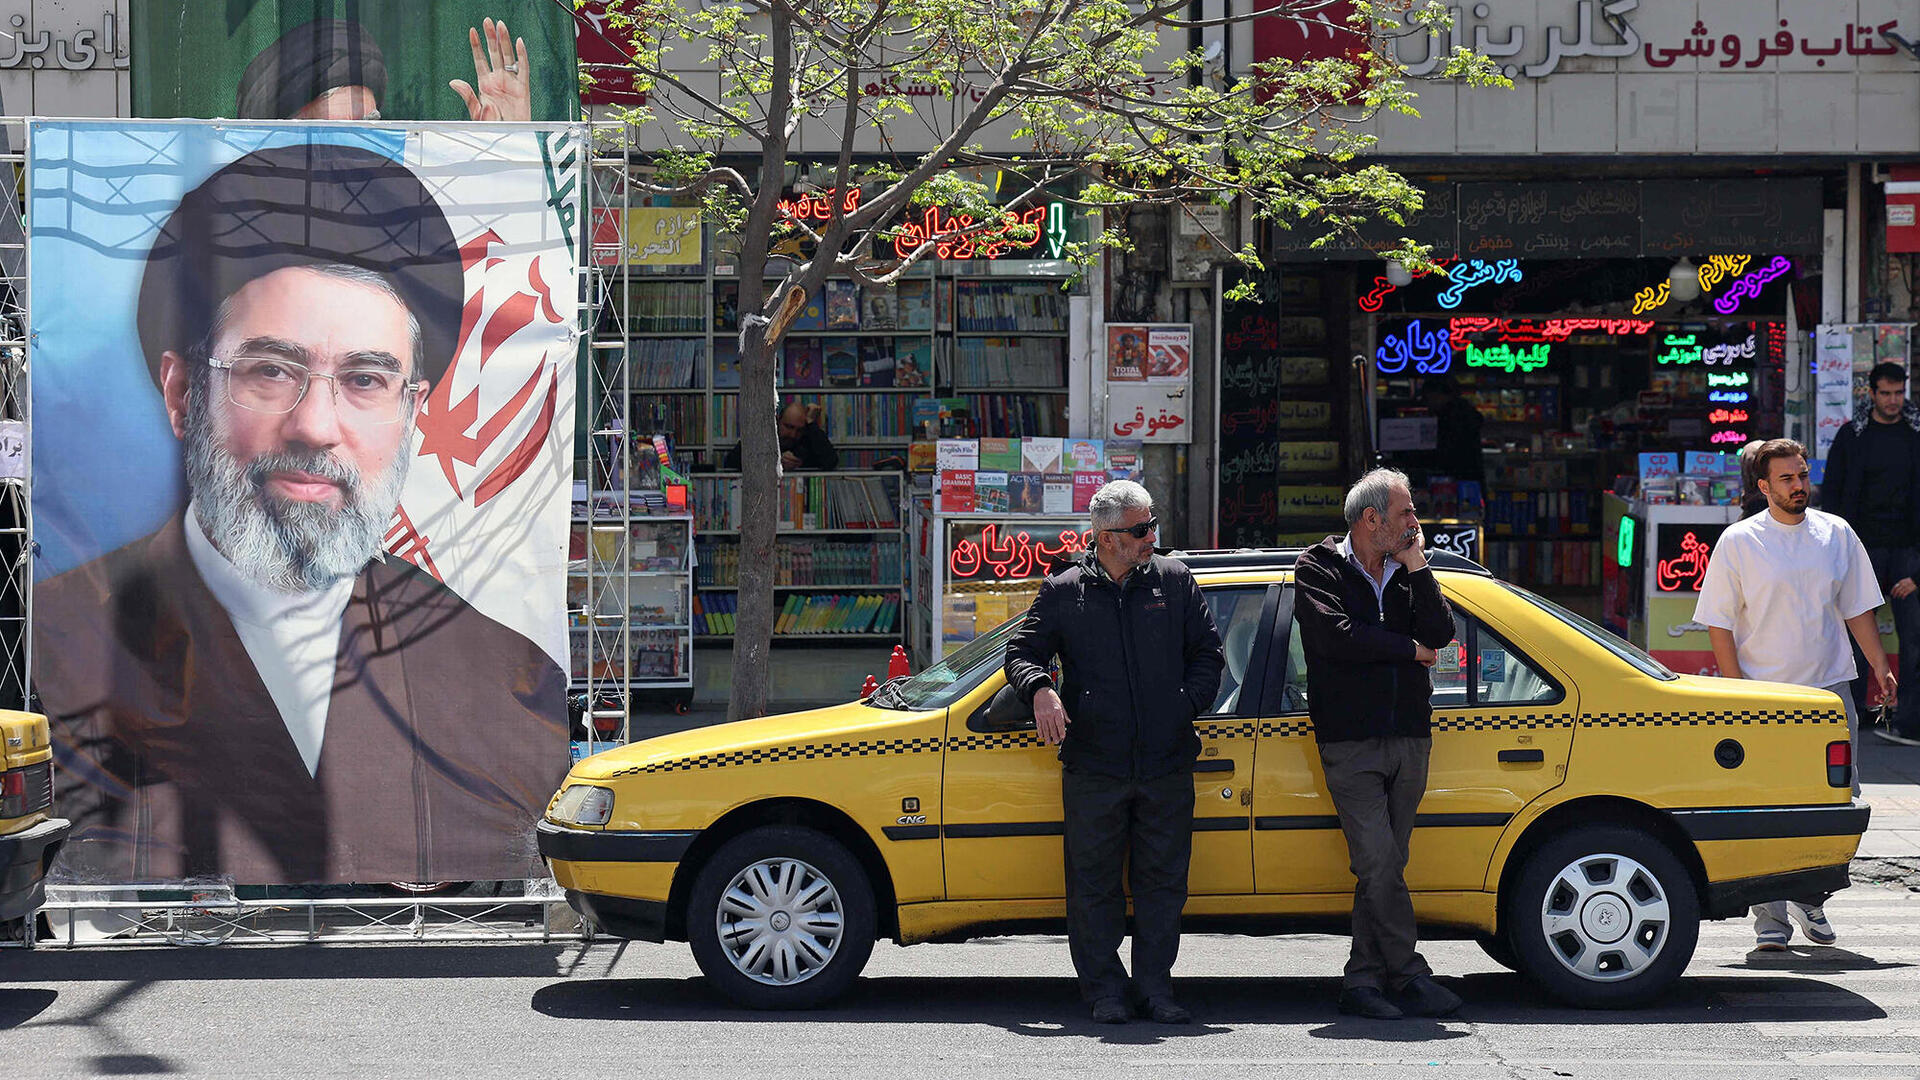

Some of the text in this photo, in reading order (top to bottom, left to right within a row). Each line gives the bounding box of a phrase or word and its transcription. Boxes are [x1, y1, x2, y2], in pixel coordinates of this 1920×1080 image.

[1645, 20, 1794, 68] فروشی
[655, 213, 697, 235] لوازم
[1468, 232, 1633, 253] عمومی پزشکی حقوقی
[1437, 258, 1523, 309] پزشکی
[1714, 255, 1792, 314] عمومی
[1152, 334, 1179, 342] Headway
[1663, 333, 1697, 346] تست
[1376, 319, 1452, 374] زبان
[1657, 345, 1703, 364] آموزشی
[1115, 366, 1139, 374] TOTAL
[1113, 406, 1185, 437] حقوقی
[940, 446, 962, 454] English
[1650, 455, 1669, 464] CD
[1696, 454, 1715, 464] CD
[1010, 475, 1041, 484] ACTIVE
[1075, 475, 1105, 485] IELTS
[951, 523, 1033, 578] زبان
[896, 815, 927, 825] CNG
